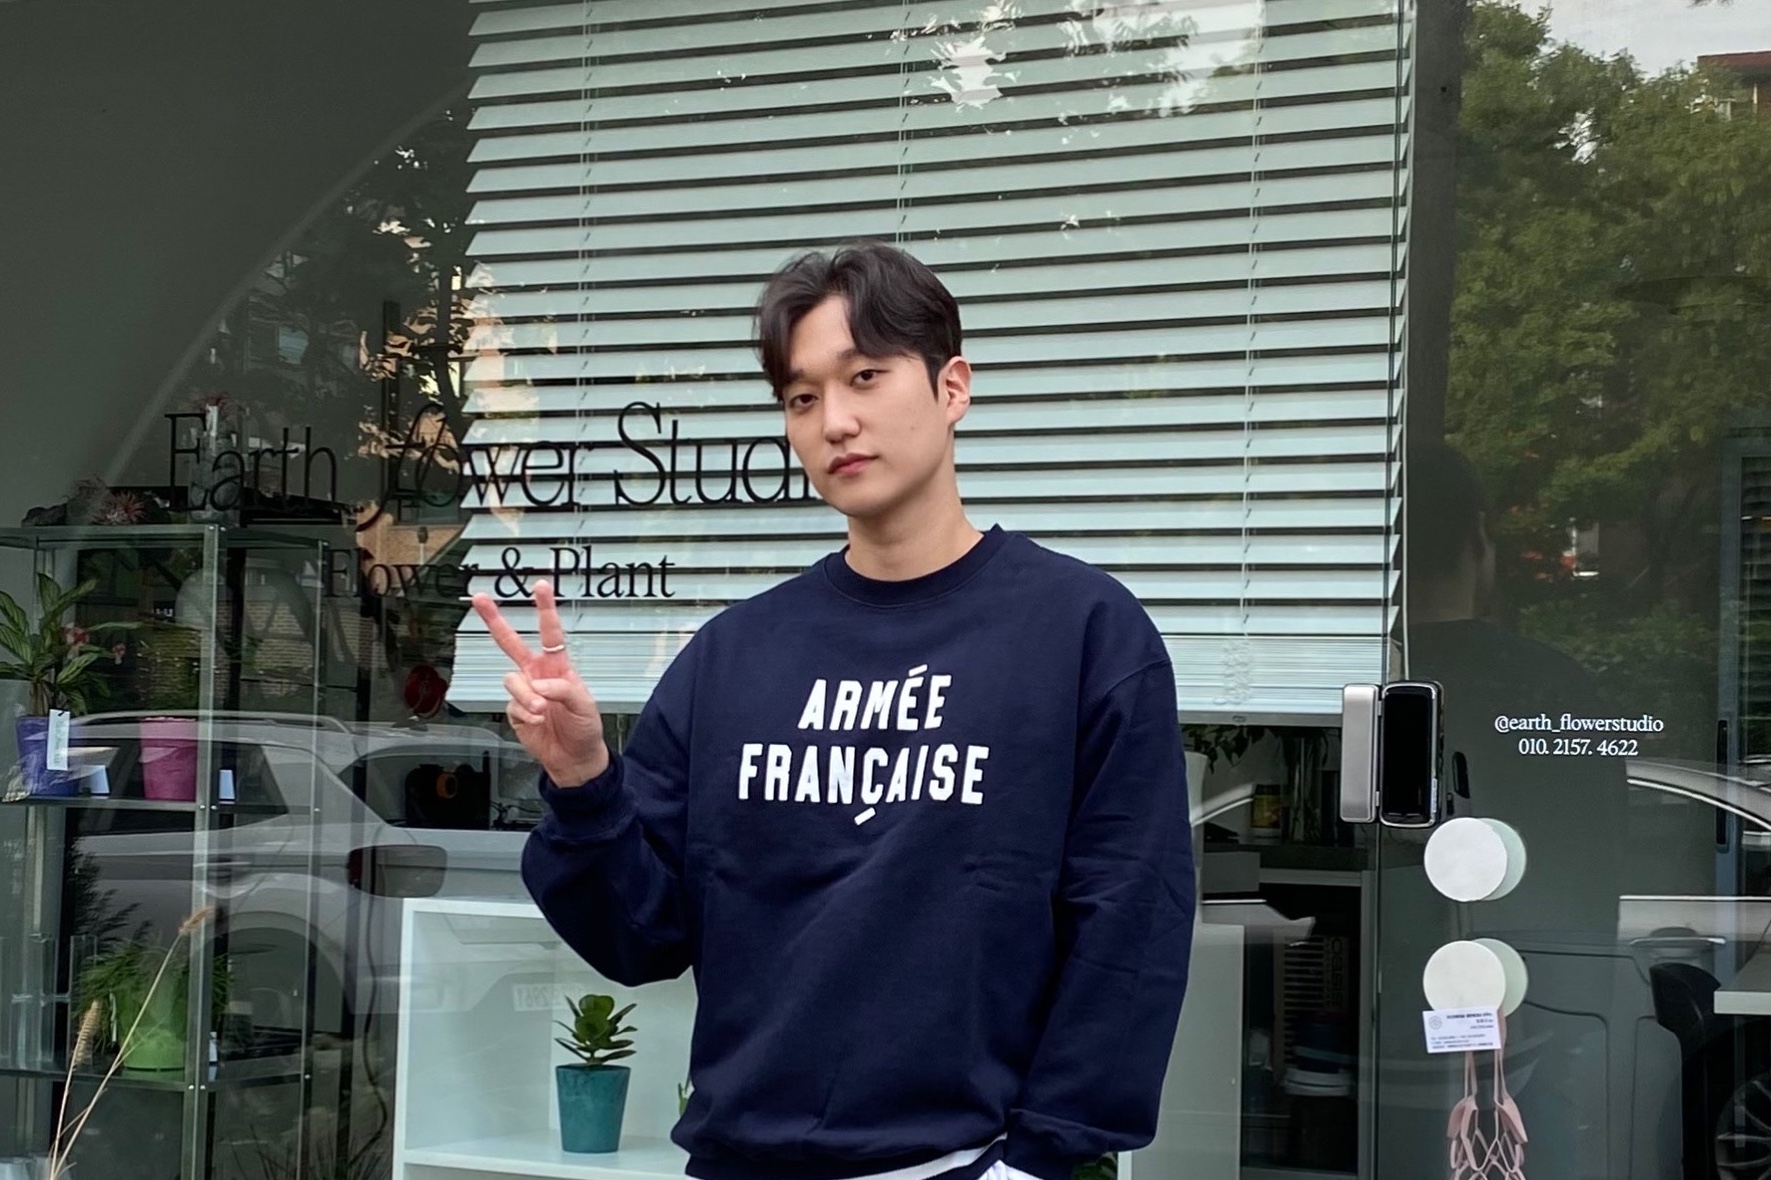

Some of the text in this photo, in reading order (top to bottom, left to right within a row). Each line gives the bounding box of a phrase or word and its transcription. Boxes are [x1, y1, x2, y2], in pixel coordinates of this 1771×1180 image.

[164, 412, 340, 512] Earth
[324, 545, 676, 599] Flower & Plant
[797, 664, 952, 731] ARMÉE
[1494, 713, 1665, 733] @earth_flowerstudio
[1596, 739, 1639, 756] 4622
[738, 743, 990, 826] FRANÇAISE
